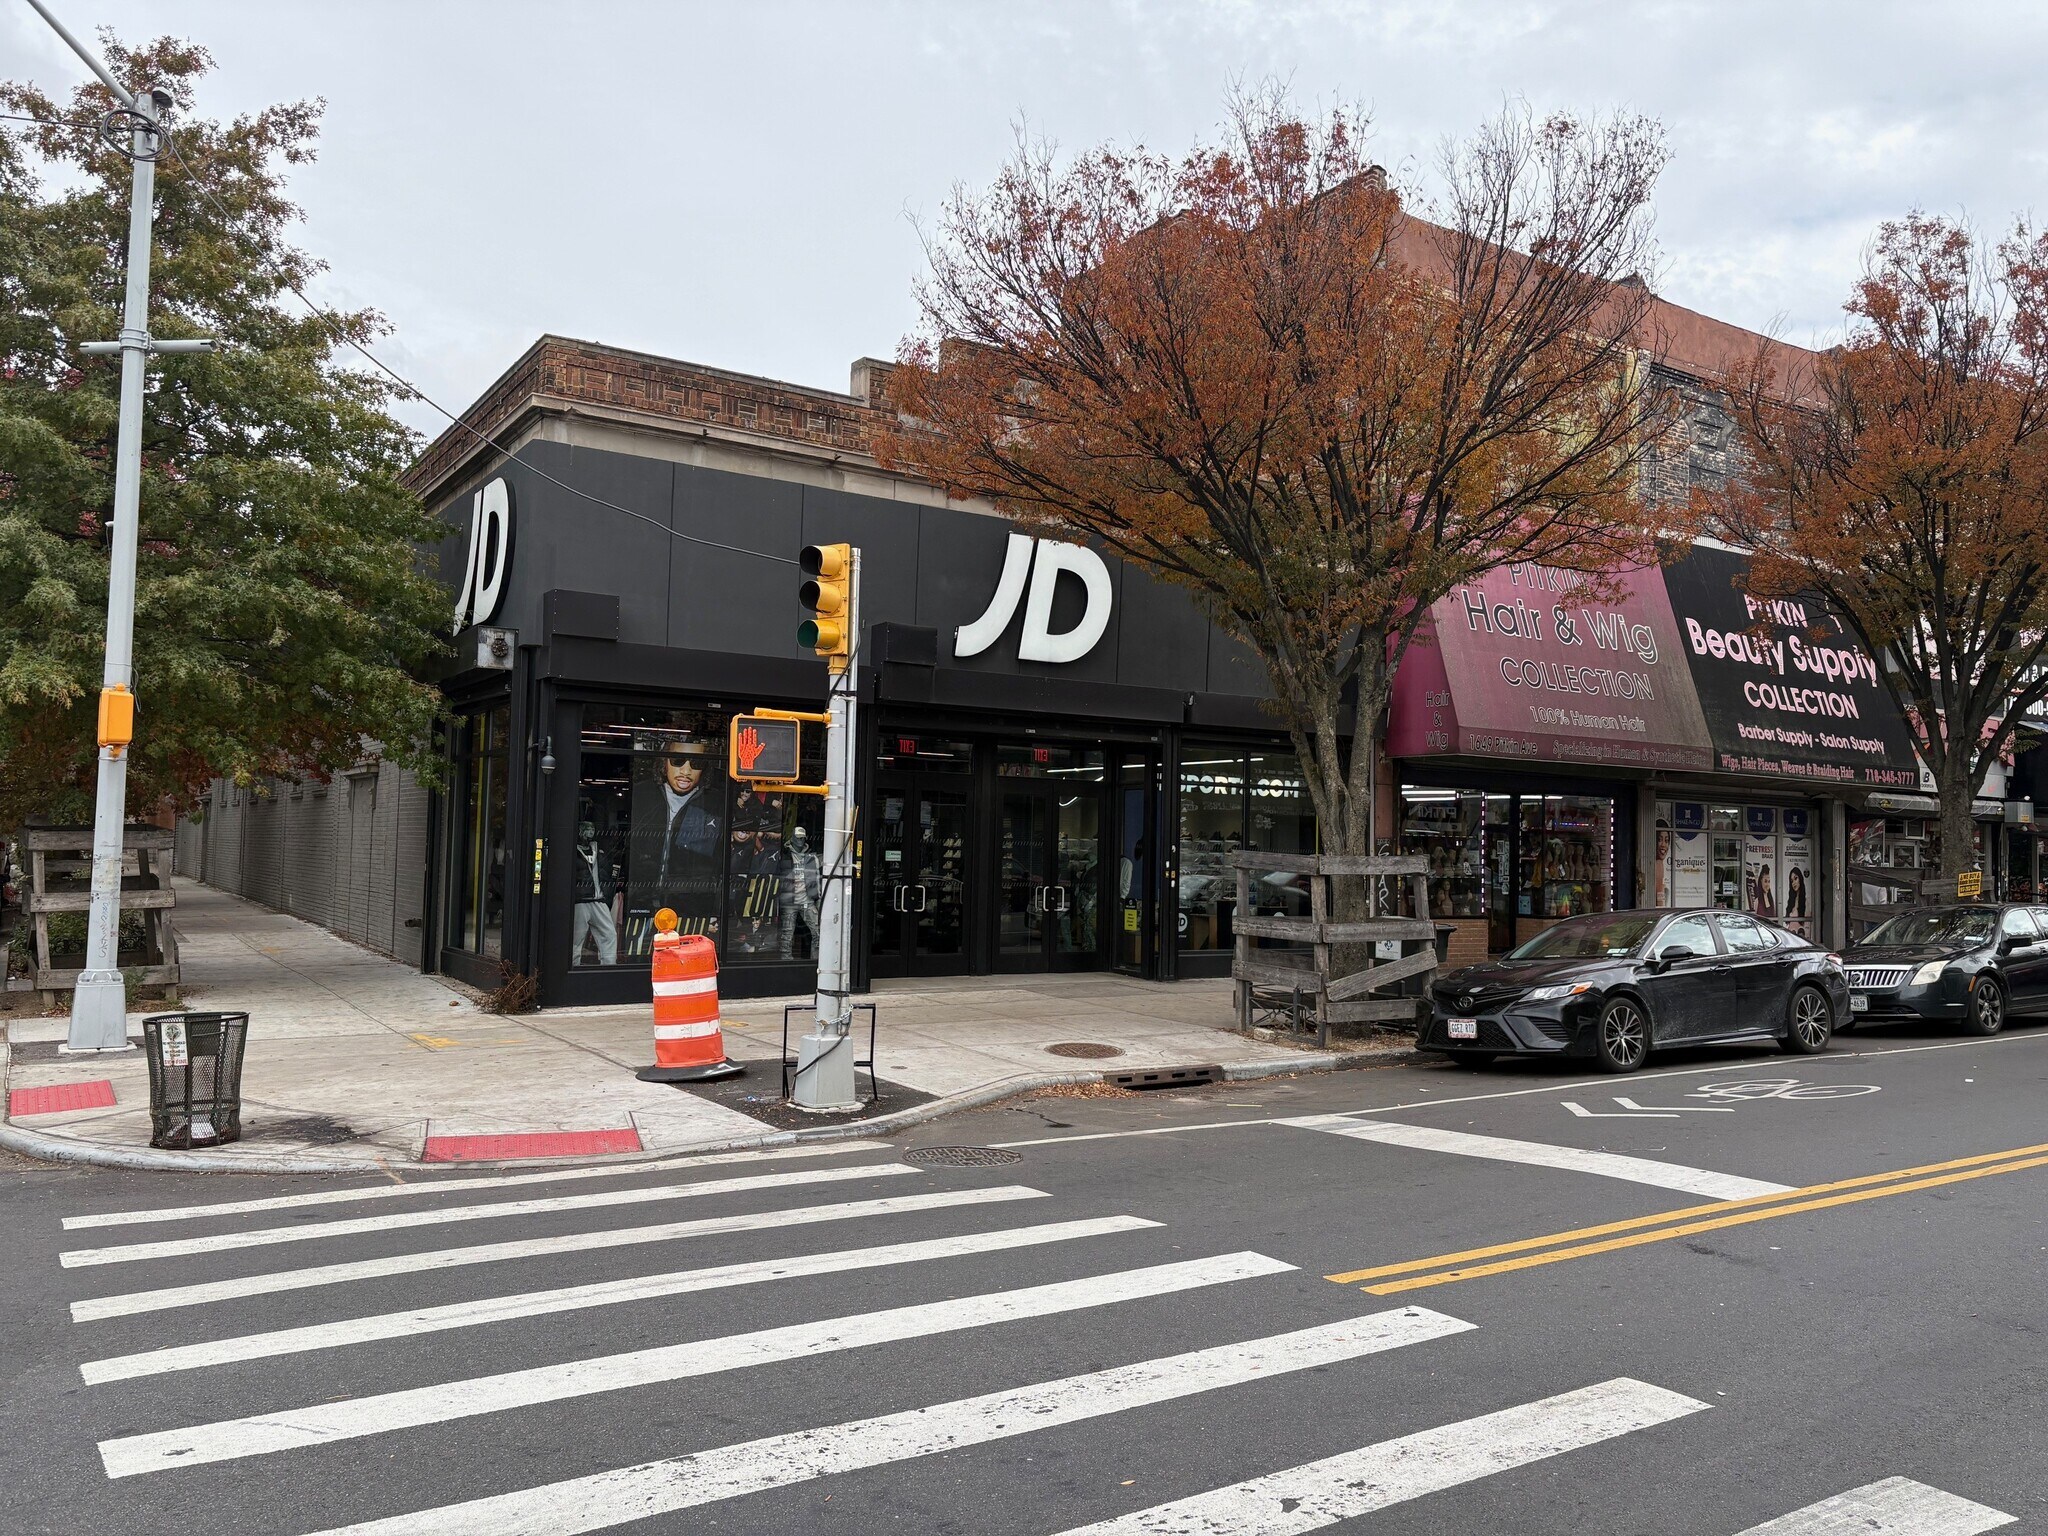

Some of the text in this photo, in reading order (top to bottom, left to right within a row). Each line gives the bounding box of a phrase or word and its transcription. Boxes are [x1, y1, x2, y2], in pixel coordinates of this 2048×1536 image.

[453, 477, 512, 638] JD
[954, 532, 1113, 663] JD
[1461, 589, 1659, 664] Hair & Wig
[1500, 656, 1655, 701] COLLECTION
[1426, 691, 1450, 708] Hair
[1744, 681, 1860, 719] COLLECTION
[1432, 711, 1443, 727] &
[1530, 706, 1647, 732] 100% Human Hair
[1425, 731, 1449, 750] Wig
[1469, 734, 1538, 755] 1649 Pitkin Ave
[1737, 723, 1776, 741] Barber
[1777, 728, 1813, 748] Supply
[1819, 733, 1849, 749] Salon
[1850, 736, 1885, 755] Supply
[1741, 756, 1756, 769] Hair
[1781, 760, 1806, 774] Weaves
[1806, 762, 1812, 774] &
[1813, 764, 1840, 780] Braiding
[1840, 766, 1854, 779] Hair
[1864, 768, 1915, 785] 718-345-3777
